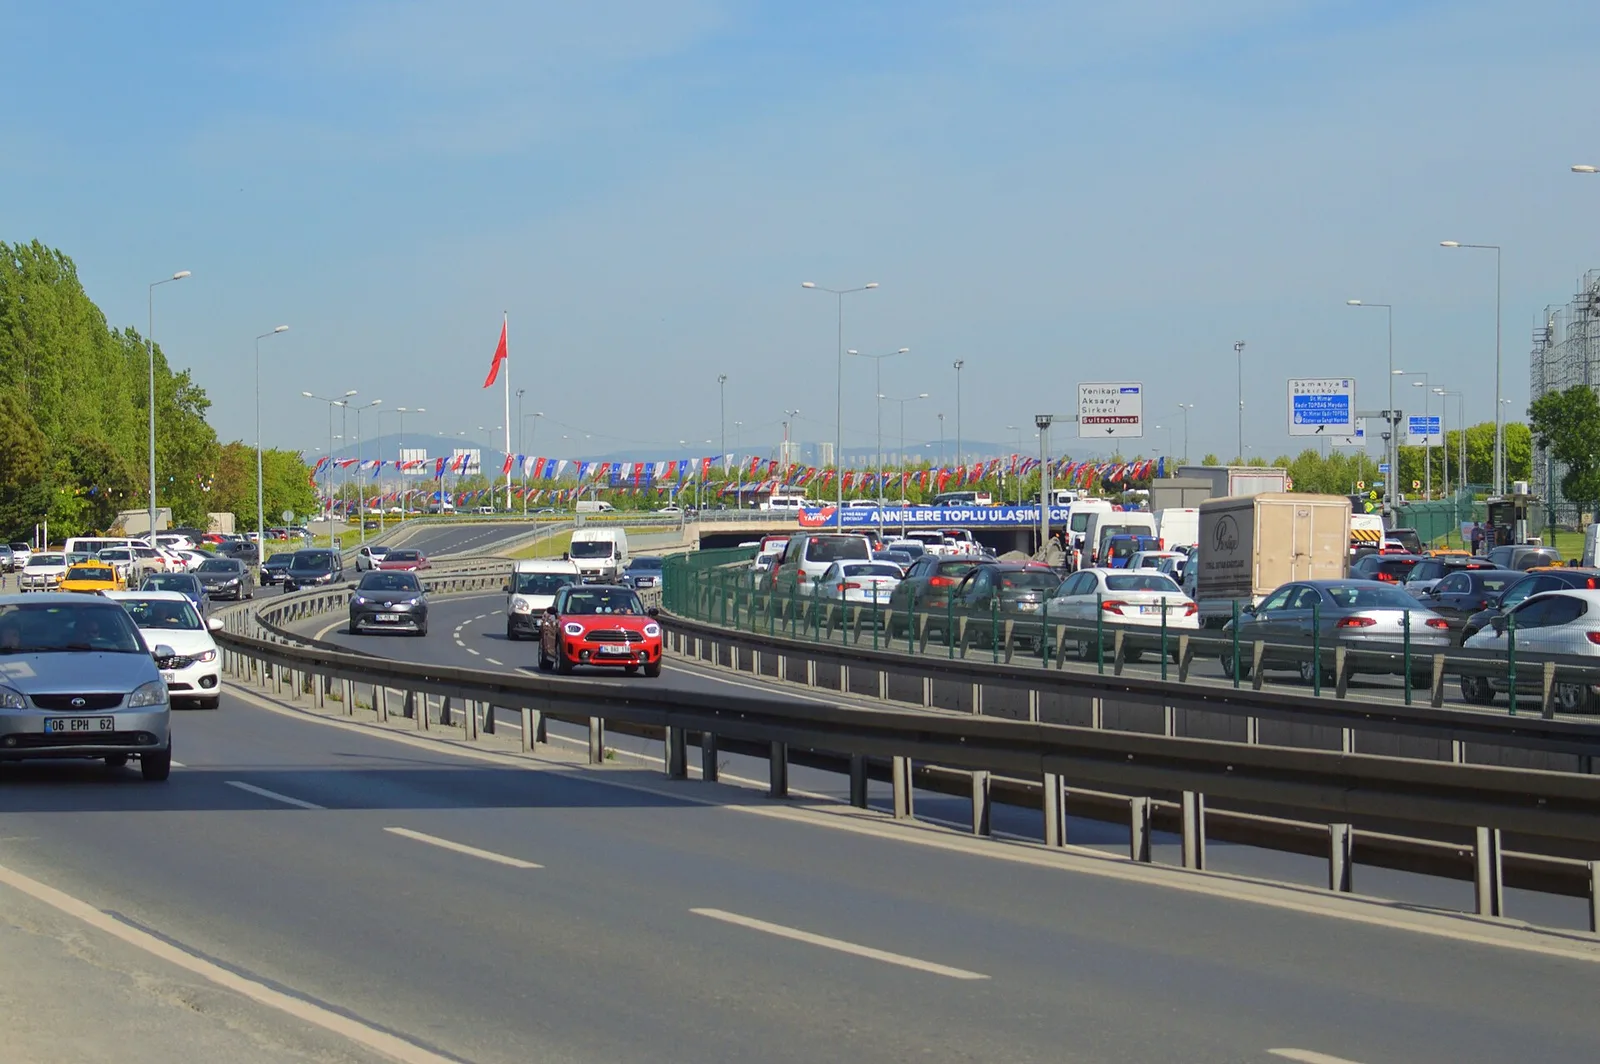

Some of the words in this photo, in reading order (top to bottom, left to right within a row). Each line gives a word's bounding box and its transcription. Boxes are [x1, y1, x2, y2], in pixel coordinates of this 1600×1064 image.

[1082, 388, 1119, 396] Yenikapı
[1082, 398, 1121, 406] Aksaray
[1082, 416, 1139, 424] Sultanahmet
[870, 511, 942, 522] ANNELERE
[943, 510, 986, 521] TOPLU
[989, 509, 1040, 523] ULAŞIM
[52, 720, 65, 731] 06
[71, 720, 89, 731] EPH
[99, 719, 112, 730] 62
